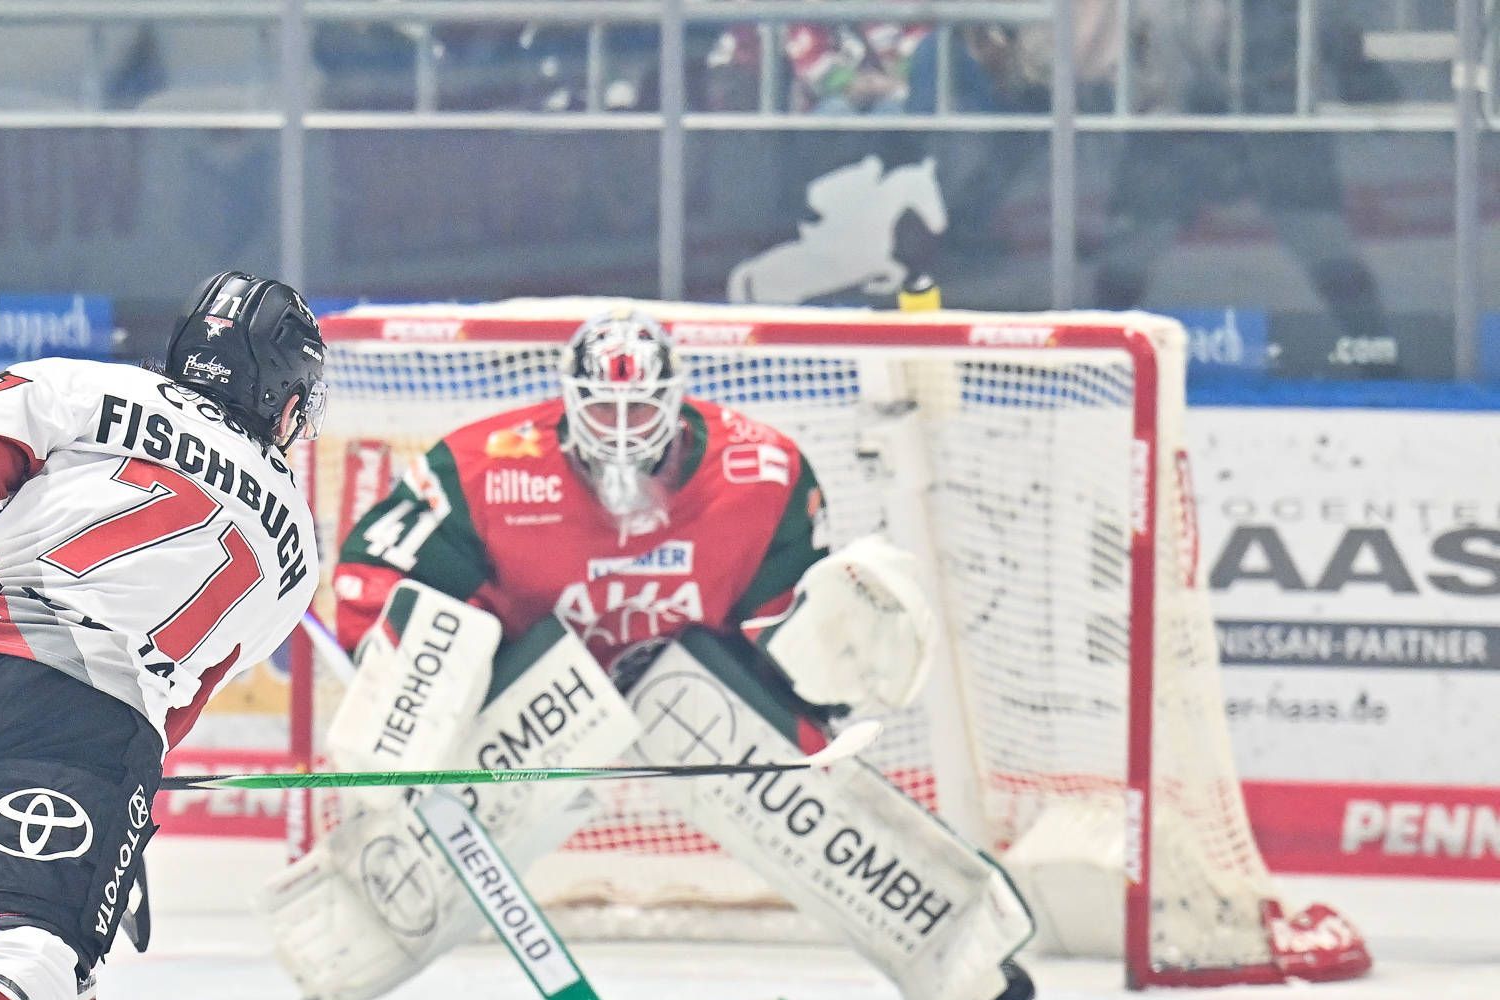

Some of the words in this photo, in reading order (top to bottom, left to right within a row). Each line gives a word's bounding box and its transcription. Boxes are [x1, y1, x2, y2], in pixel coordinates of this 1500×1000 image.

[210, 293, 242, 319] 71
[95, 393, 308, 601] FISCHBUCH
[38, 456, 265, 665] 71
[373, 607, 462, 758] TIERHOLD
[477, 666, 596, 772] GMBH
[95, 829, 141, 937] TOYOTA
[448, 821, 554, 965] TIERHOLD
[824, 827, 953, 936] GMBH
